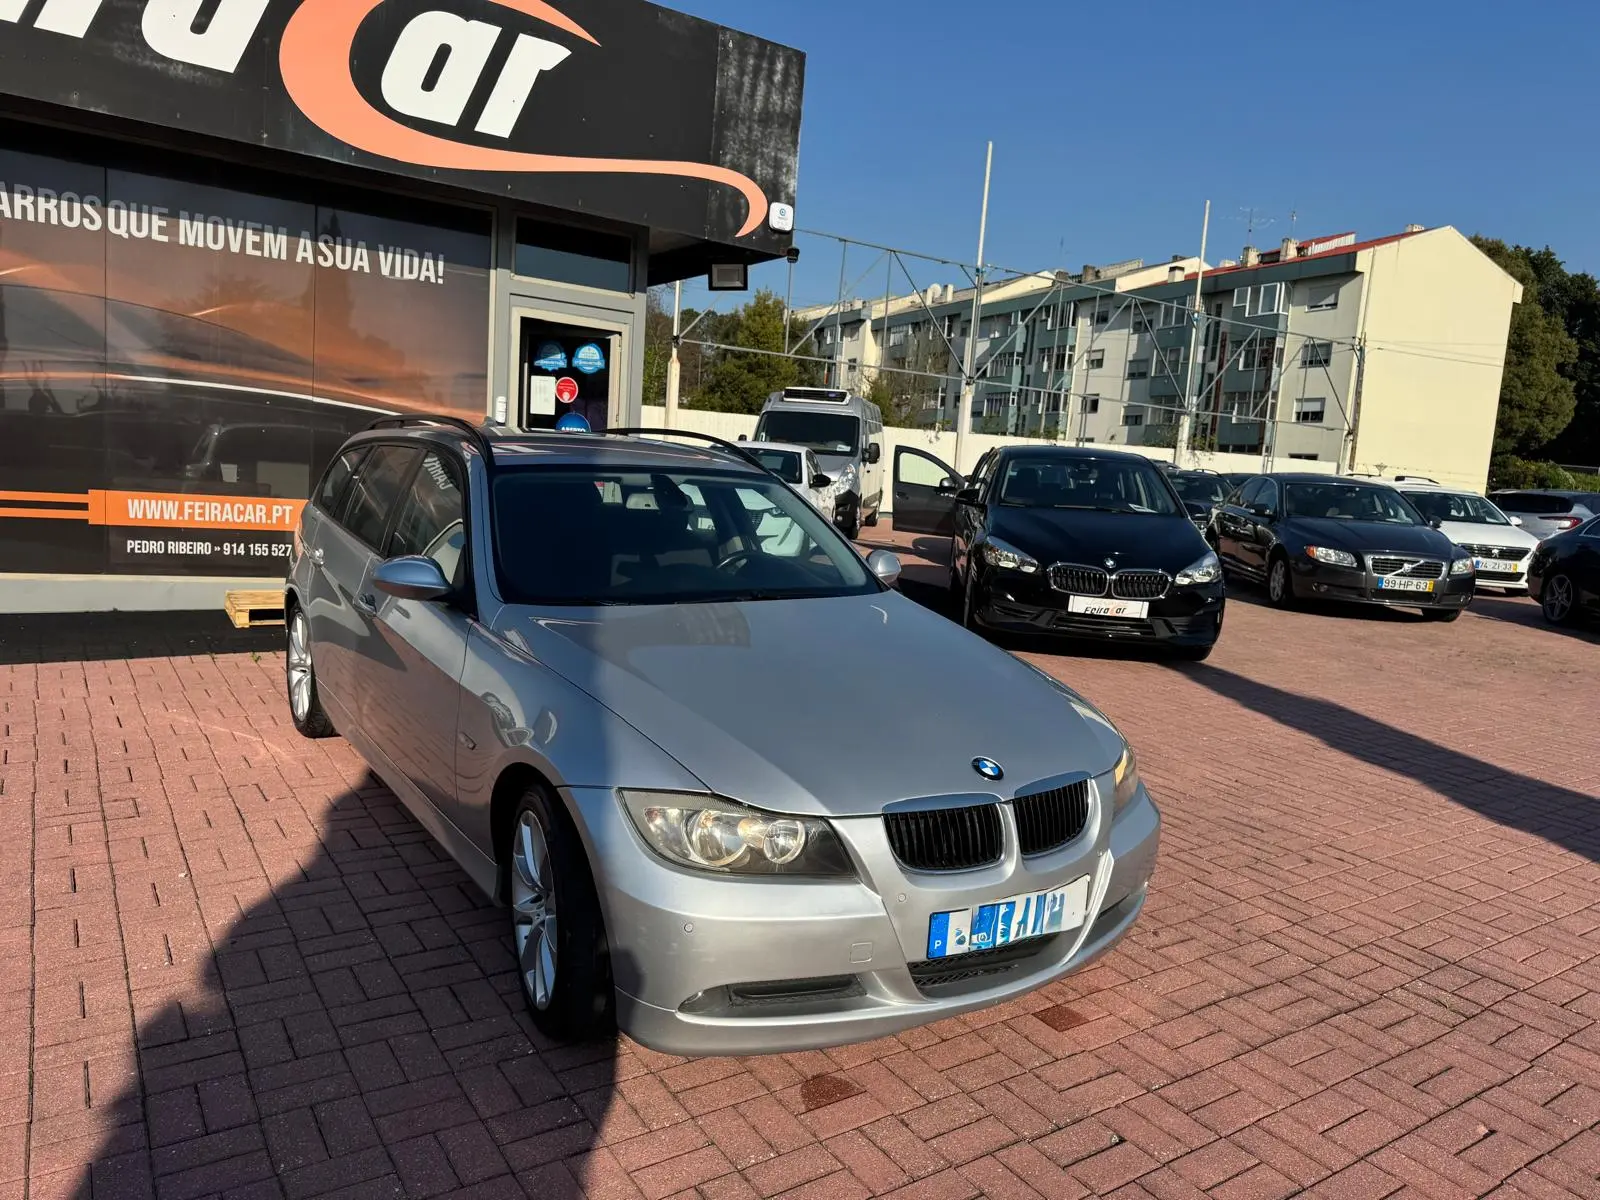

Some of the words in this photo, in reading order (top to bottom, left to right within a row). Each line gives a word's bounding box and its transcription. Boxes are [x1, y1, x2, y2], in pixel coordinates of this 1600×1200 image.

[107, 199, 169, 243] QUE
[178, 210, 288, 261] MOVEM
[378, 243, 445, 285] VIDA!
[127, 498, 294, 525] WWW.FEIRACAR.PT
[126, 539, 165, 554] PEDRO
[167, 541, 212, 555] RIBEIRO
[222, 542, 245, 556] 914
[248, 543, 268, 557] 155
[271, 544, 292, 557] 527
